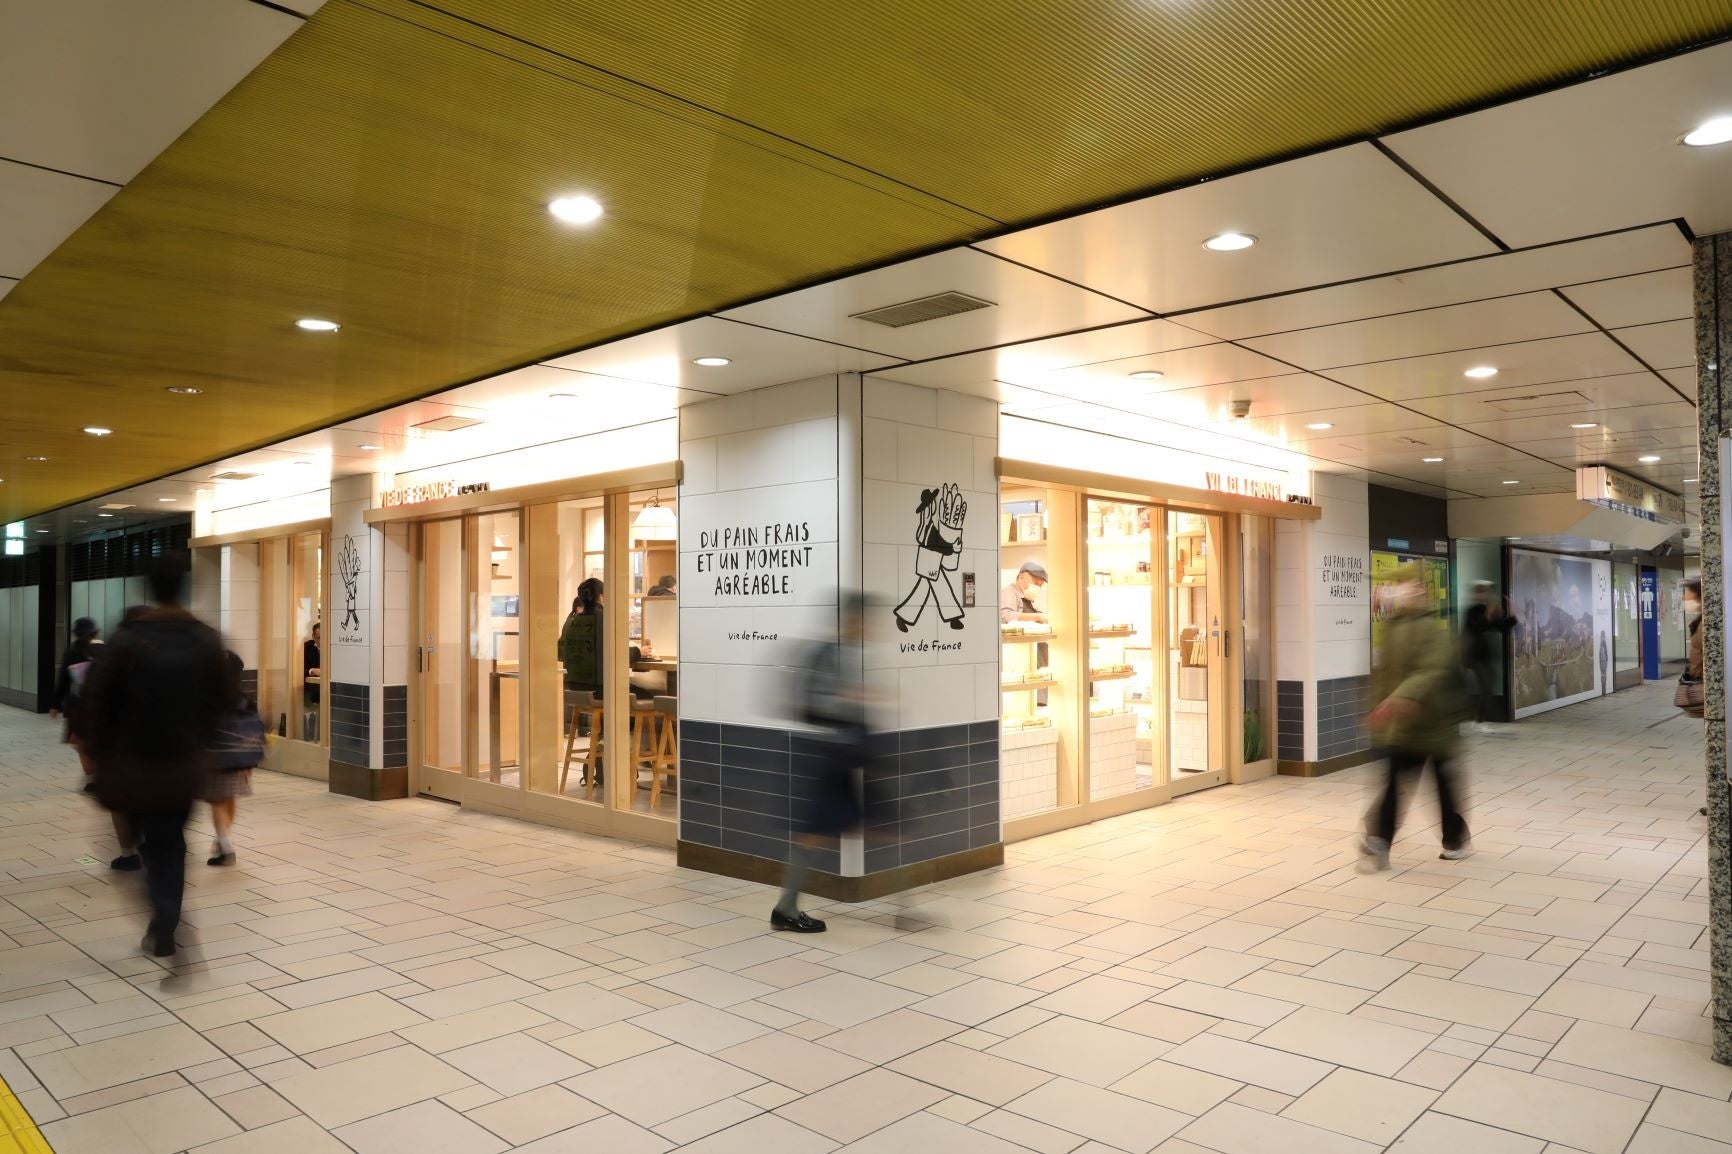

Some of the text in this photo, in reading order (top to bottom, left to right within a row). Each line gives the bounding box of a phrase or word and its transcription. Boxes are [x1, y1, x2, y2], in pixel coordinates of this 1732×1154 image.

[700, 522, 810, 549] DU PAIN FRAIS
[697, 547, 813, 573] ET UN MOMENT
[741, 630, 750, 641] de
[752, 631, 778, 641] France
[900, 638, 962, 654] Vie de France
